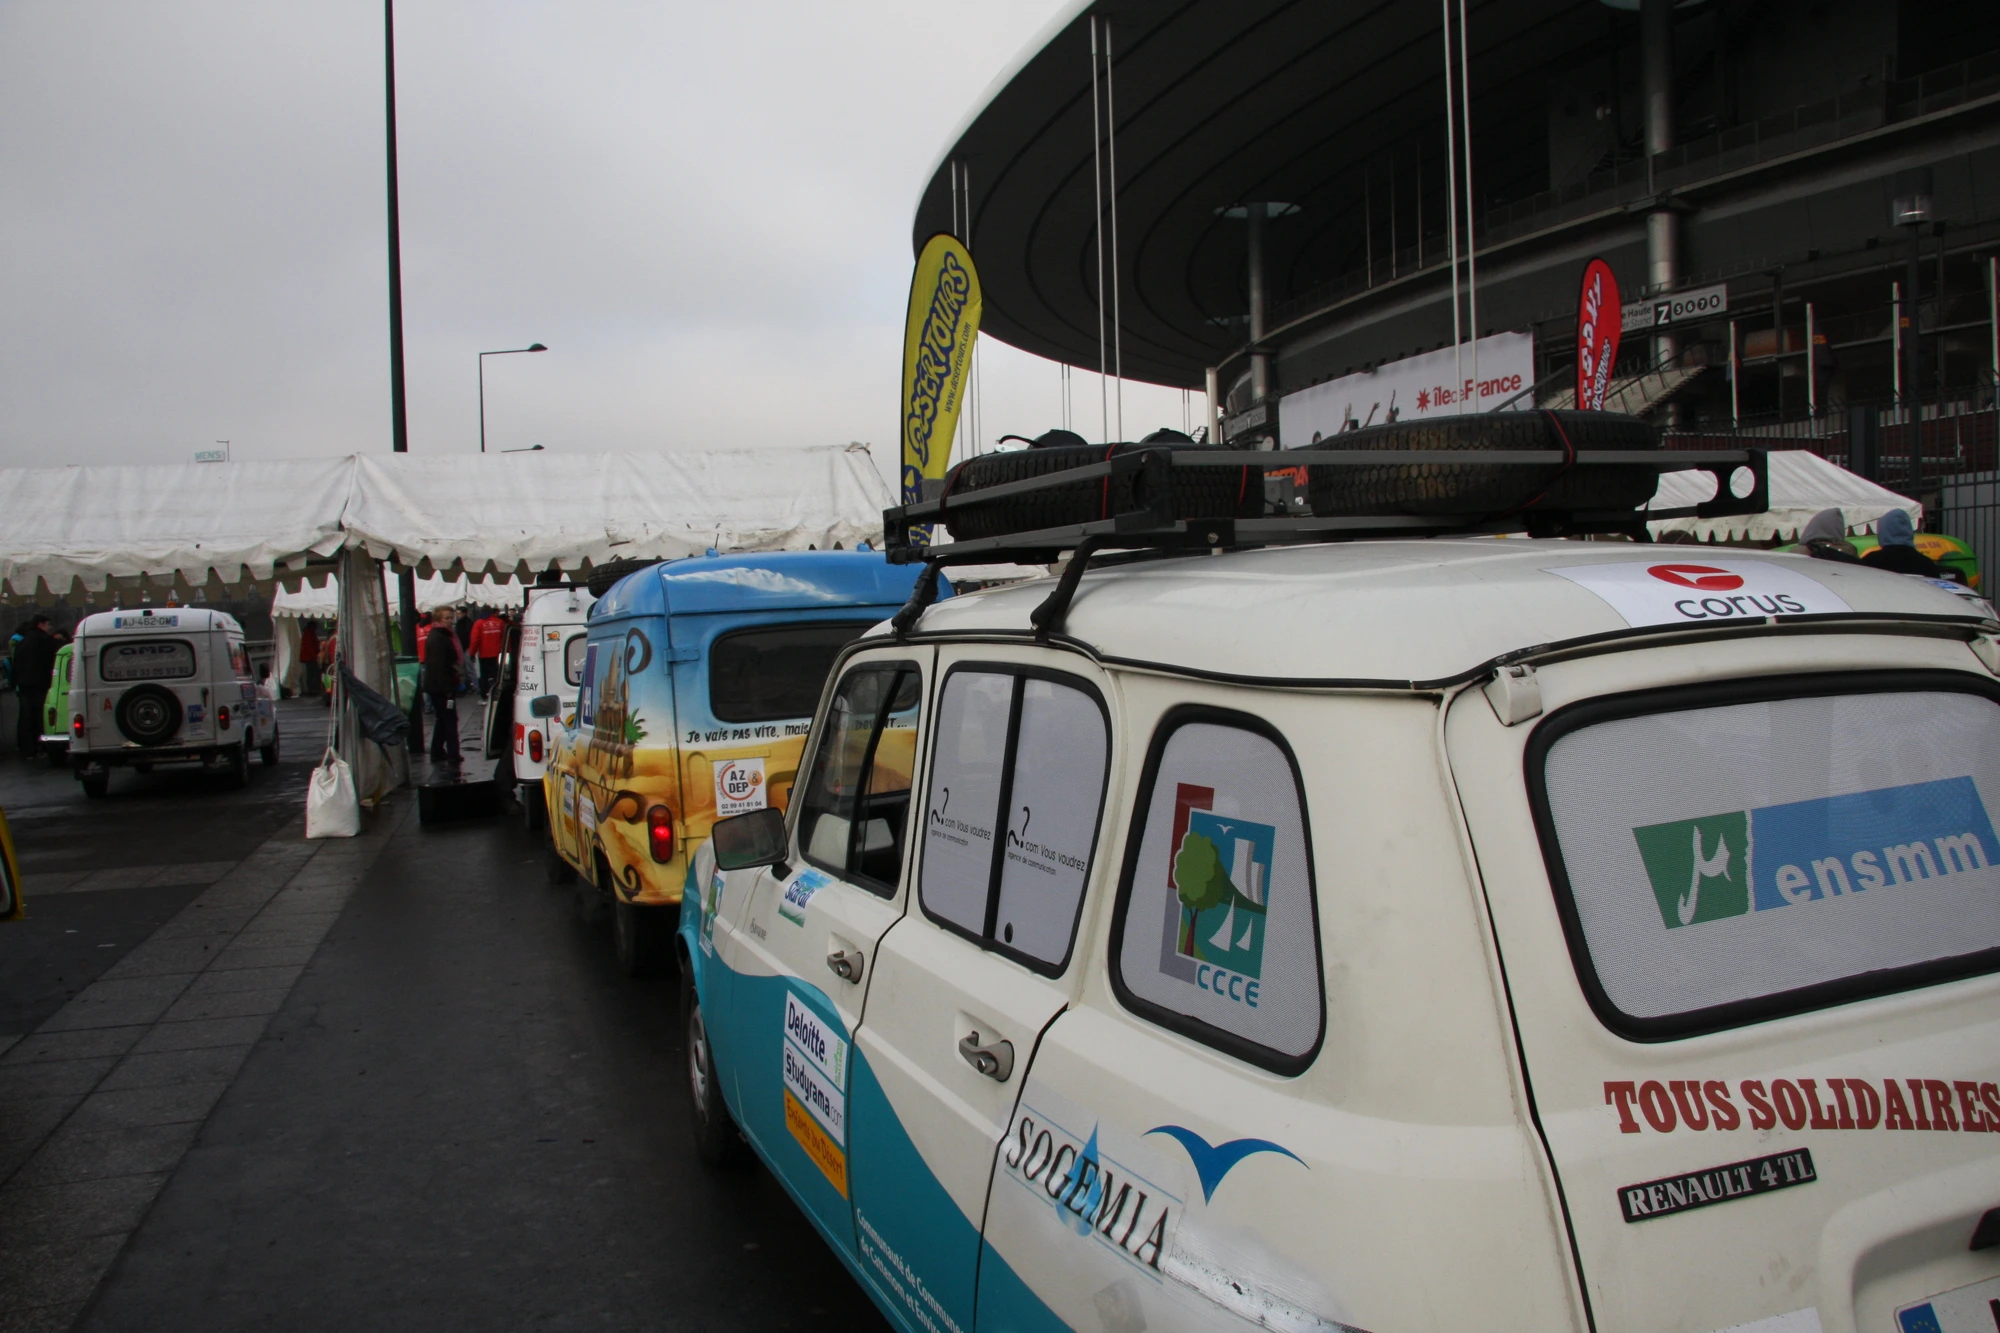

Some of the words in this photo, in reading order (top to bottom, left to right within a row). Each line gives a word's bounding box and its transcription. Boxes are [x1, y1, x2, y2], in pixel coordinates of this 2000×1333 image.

[1628, 307, 1651, 318] Haute
[1658, 305, 1669, 325] Z
[945, 322, 971, 414] www.desertours.com
[1674, 594, 1806, 619] corus
[705, 727, 729, 742] vais
[732, 728, 750, 740] PAS
[729, 782, 749, 794] DEP
[956, 819, 969, 834] Vous
[970, 825, 991, 841] voudrez
[1007, 851, 1022, 863] agence
[1041, 842, 1056, 861] Vous
[1058, 852, 1086, 872] voudrez
[1775, 832, 1989, 906] ensmm
[1197, 964, 1260, 1008] CCCE
[1603, 1080, 1741, 1134] TOUS
[1740, 1078, 2000, 1134] SOLIDAIRES
[1006, 1116, 1168, 1273] SOGEMIA
[1626, 1166, 1752, 1218] RENAULT
[856, 1207, 905, 1276] Communauté
[905, 1264, 917, 1289] de
